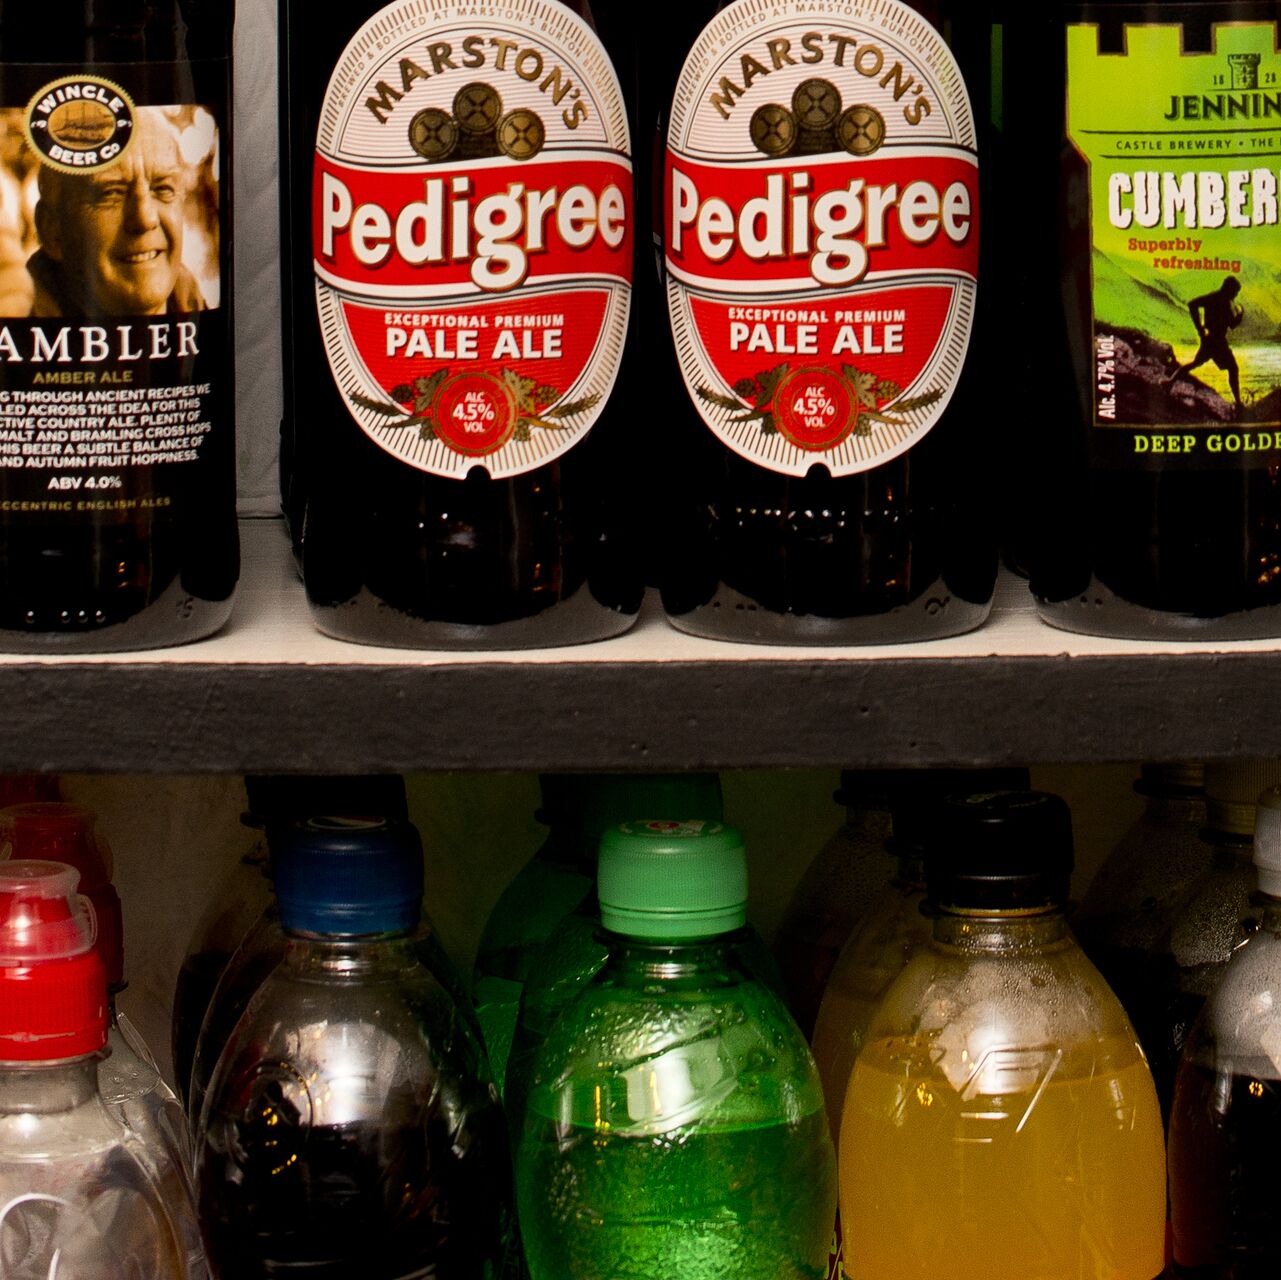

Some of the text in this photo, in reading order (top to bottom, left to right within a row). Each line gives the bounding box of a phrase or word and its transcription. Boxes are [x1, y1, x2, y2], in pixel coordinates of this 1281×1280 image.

[363, 34, 590, 132] MARSTON'S
[707, 31, 933, 127] MARSTON'S
[36, 84, 127, 115] WINCLE
[1115, 139, 1164, 152] CASTLE
[1169, 137, 1233, 151] BREWERY
[1250, 137, 1274, 149] THE
[48, 144, 98, 167] BEER
[319, 170, 628, 292] Pedigree
[671, 165, 973, 287] Pedigree
[1127, 236, 1202, 254] Superbly
[1152, 255, 1242, 274] refreshing
[384, 312, 565, 328] EXCEPTIONAL PREMIUM
[386, 328, 563, 360] PALE ALE
[729, 323, 905, 356] PALE ALE
[33, 370, 134, 385] AMBER ALE
[464, 391, 486, 404] ALC
[452, 401, 496, 423] 4.5%
[463, 421, 486, 433] VOL
[1134, 435, 1197, 454] DEEP
[48, 475, 123, 491] ABV 4.0%
